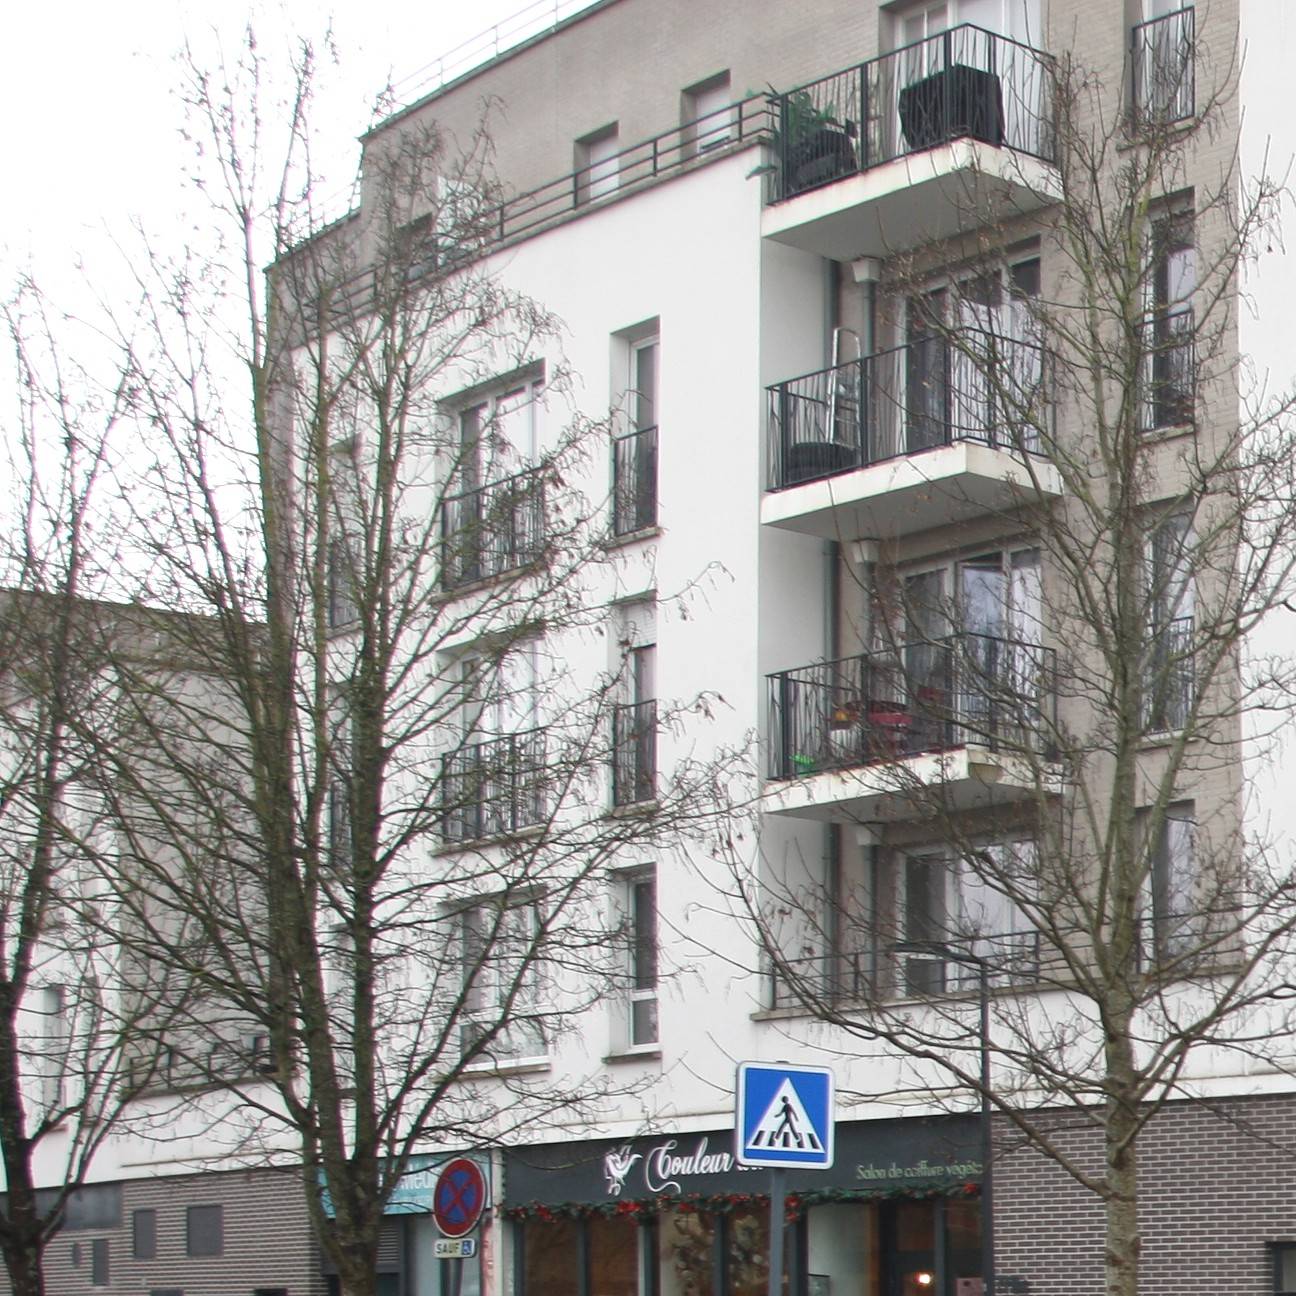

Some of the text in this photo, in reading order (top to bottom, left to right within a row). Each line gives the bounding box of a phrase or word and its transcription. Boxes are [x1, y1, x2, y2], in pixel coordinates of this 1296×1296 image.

[646, 1136, 735, 1195] Couleur
[856, 1163, 887, 1180] Salon
[888, 1162, 903, 1179] de
[436, 1242, 460, 1254] SAUF
